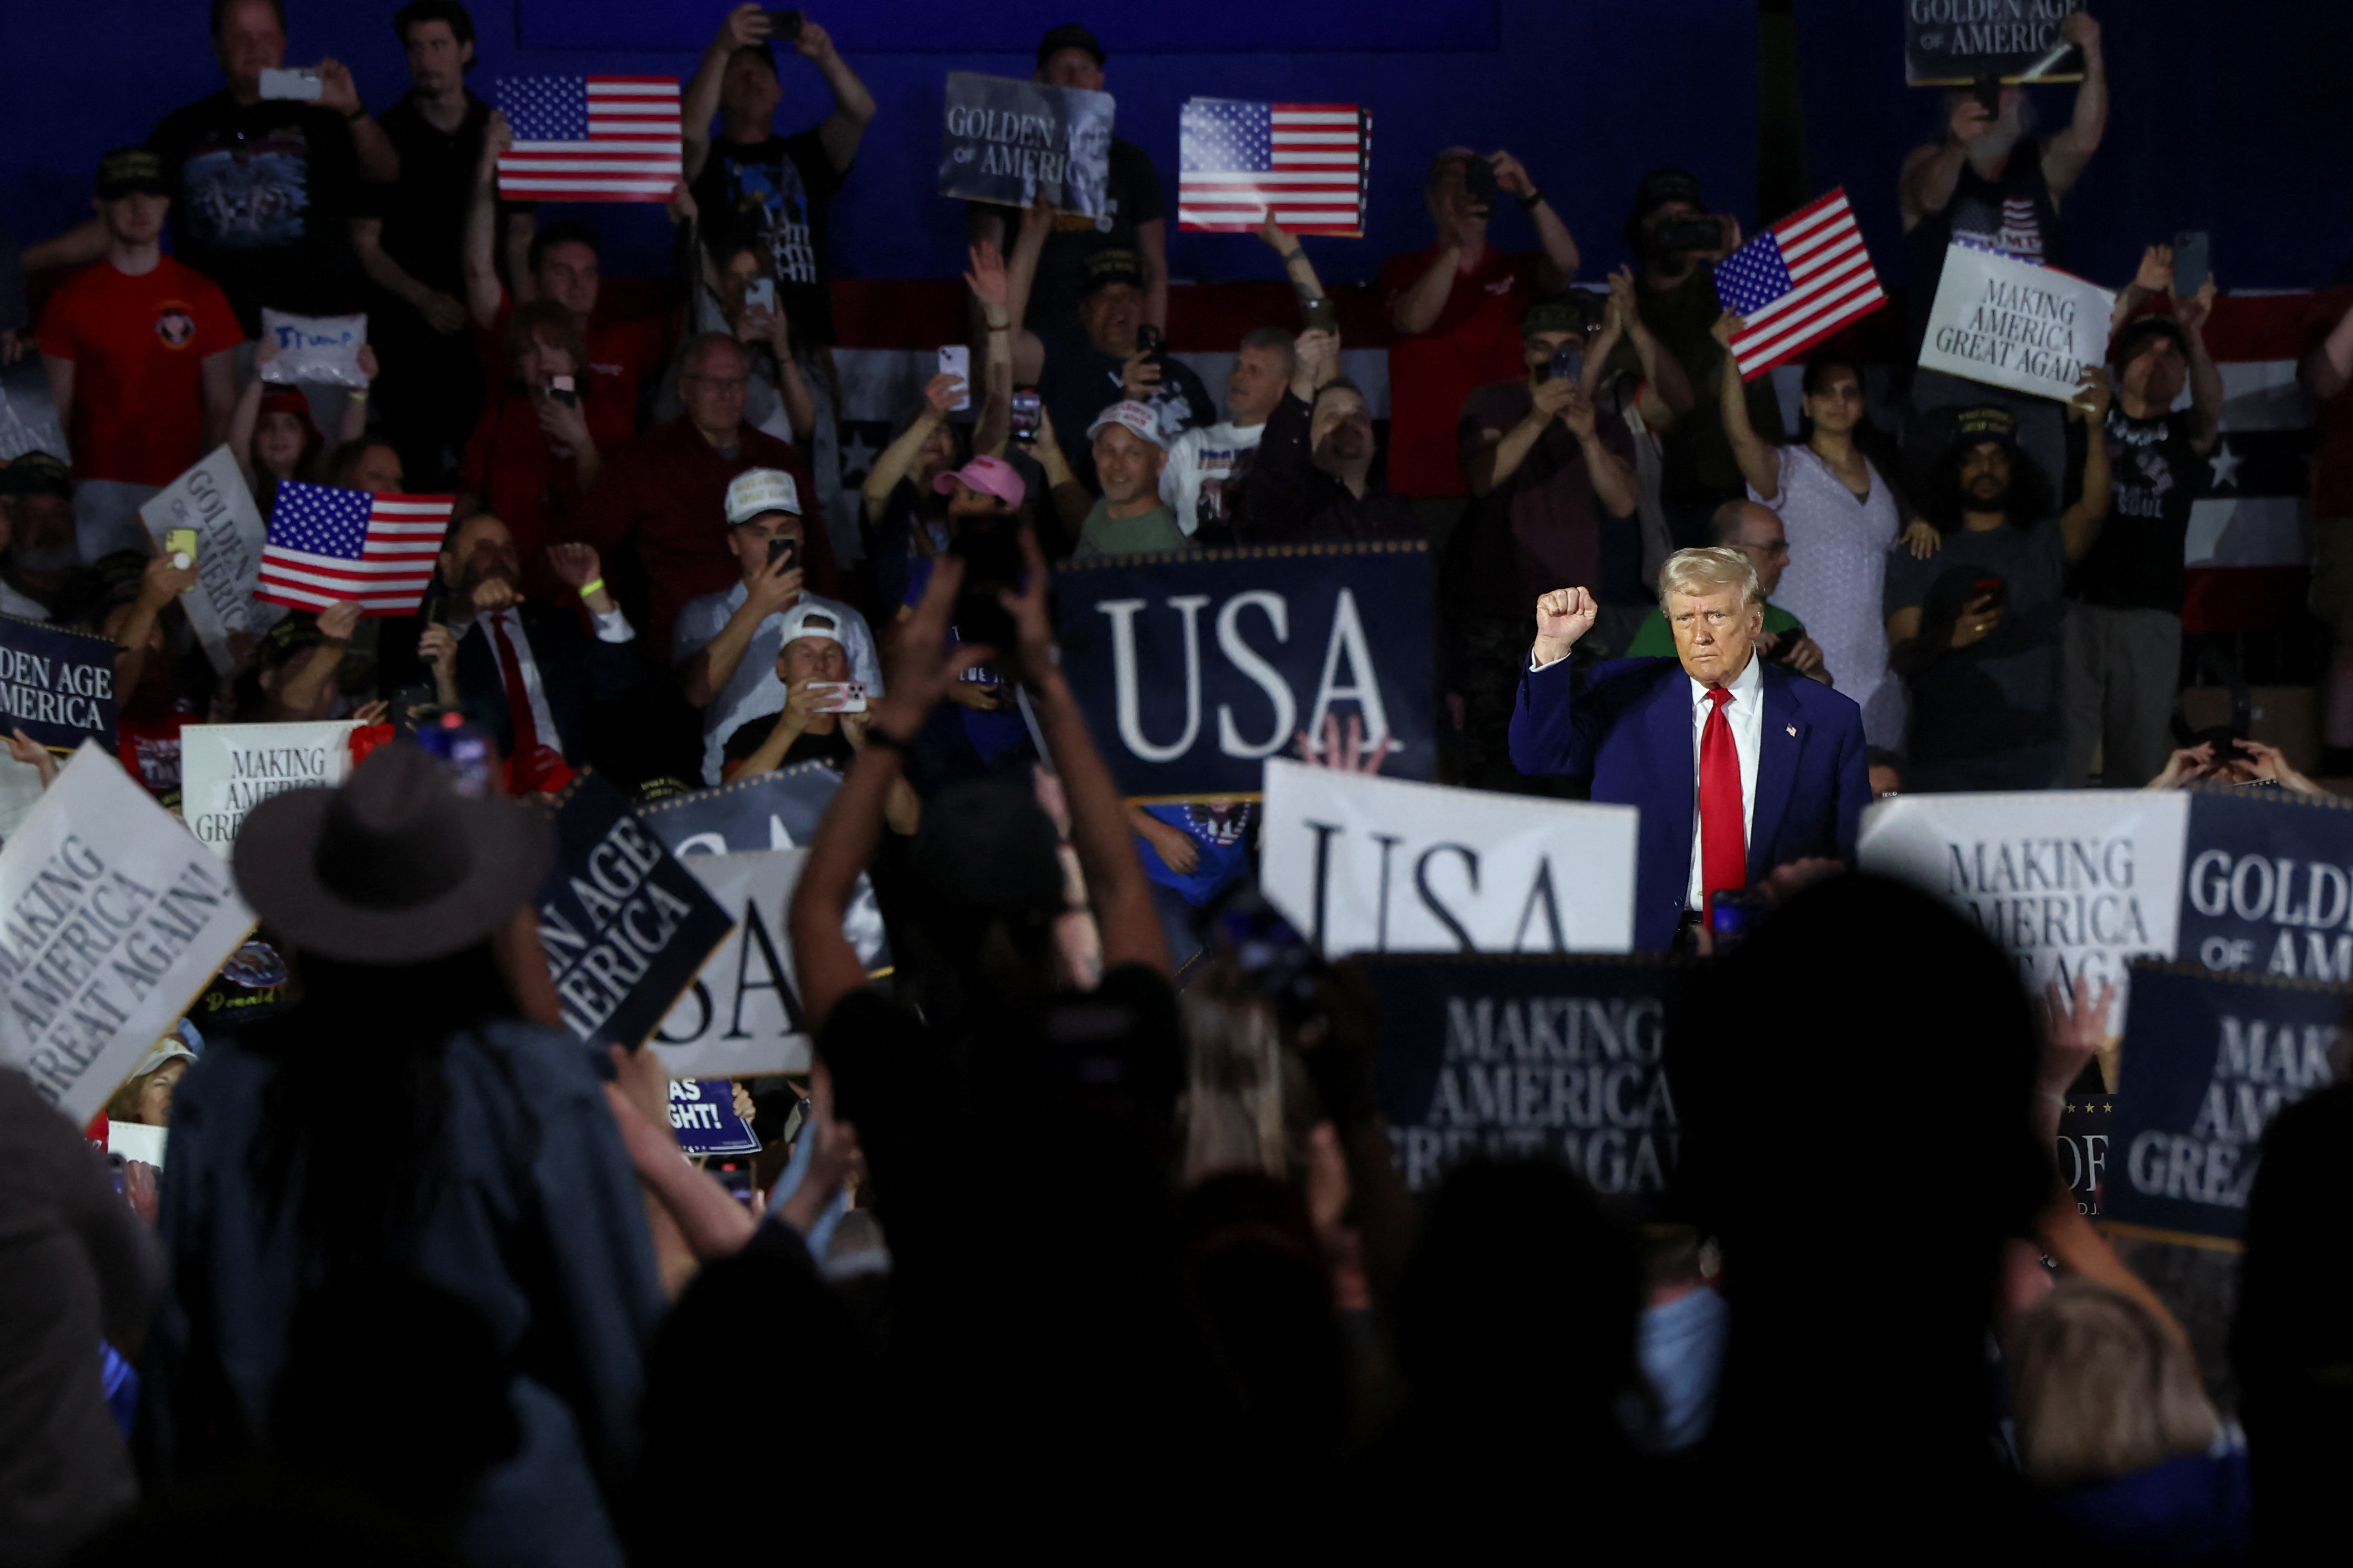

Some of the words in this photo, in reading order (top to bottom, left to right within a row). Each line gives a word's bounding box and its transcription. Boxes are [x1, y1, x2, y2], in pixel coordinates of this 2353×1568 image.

[1910, 0, 2022, 24] GOLDEN
[1950, 23, 2062, 55] AMERIC
[947, 104, 1056, 149] GOLDEN
[980, 144, 1085, 188] AMERIC
[1983, 278, 2075, 326] MAKING
[1936, 324, 2015, 367] GREAT
[1968, 306, 2074, 355] AMERICA
[188, 469, 254, 583] GOLDEN
[56, 661, 112, 700] AGE
[1093, 586, 1405, 764] USA
[232, 748, 326, 779] MAKING
[195, 813, 245, 842] GRE
[568, 815, 663, 933] AGE
[1305, 820, 1569, 955] USA
[1950, 837, 2134, 892] MAKING
[2189, 848, 2353, 928] GOLD
[111, 862, 229, 1003] AGAIN!
[1967, 895, 2148, 947] MERICA
[10, 871, 157, 1045] AMERICA
[2200, 935, 2253, 972] OF
[204, 987, 276, 1012] Donald
[1445, 996, 1666, 1063] MAKING
[2216, 1014, 2339, 1088] MAK
[1425, 1062, 1678, 1129] AMERICA
[2192, 1081, 2290, 1144] AM
